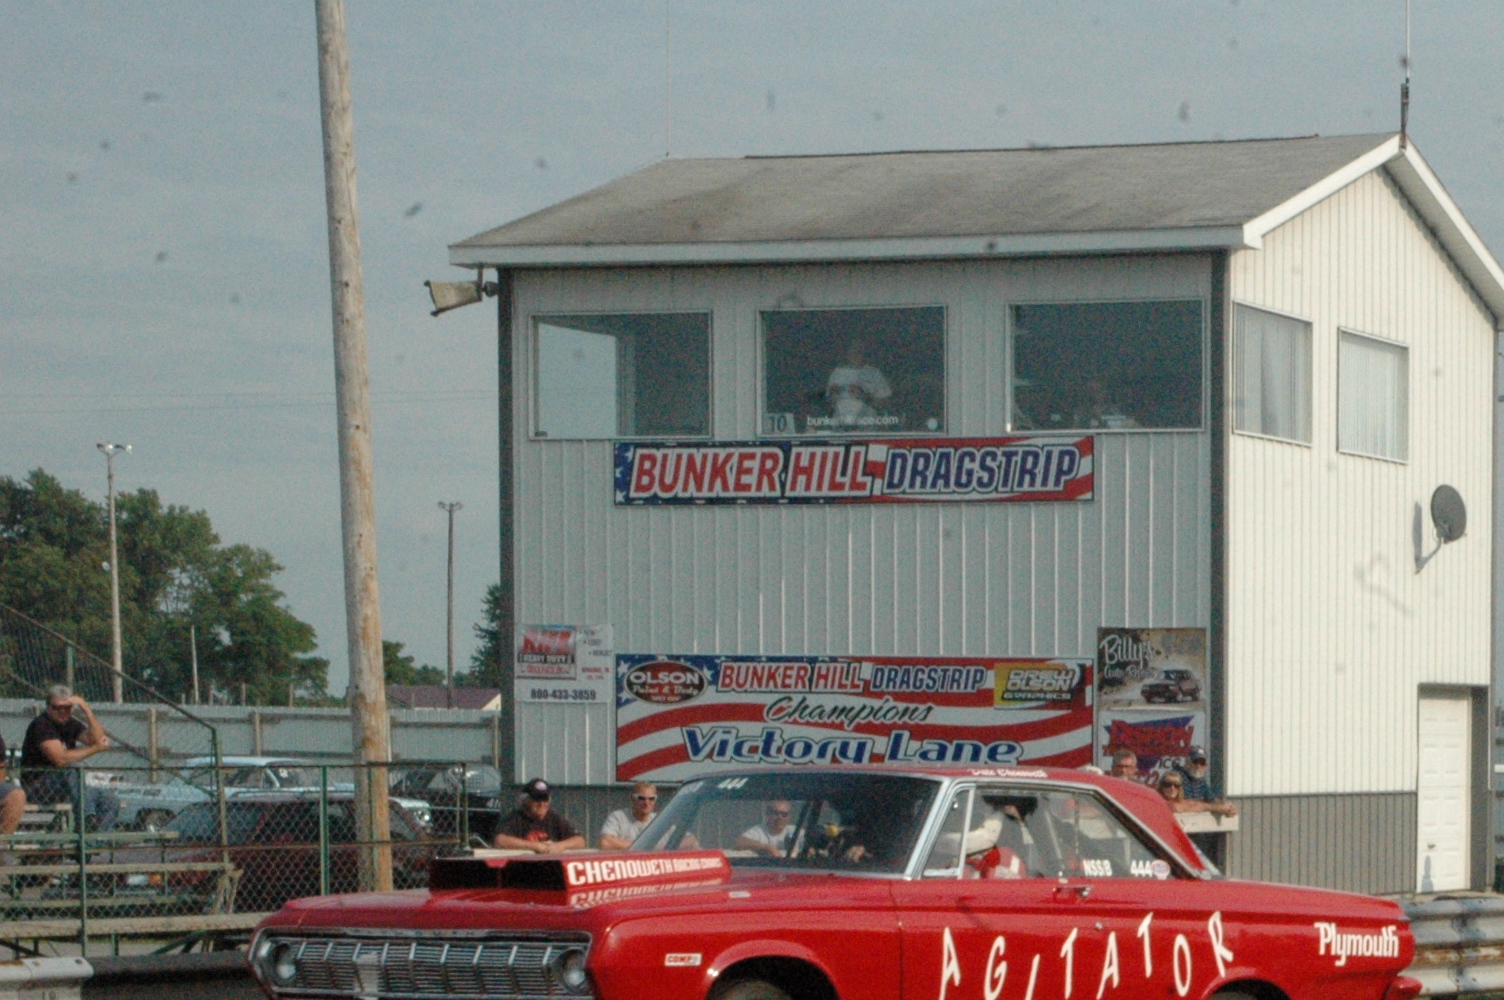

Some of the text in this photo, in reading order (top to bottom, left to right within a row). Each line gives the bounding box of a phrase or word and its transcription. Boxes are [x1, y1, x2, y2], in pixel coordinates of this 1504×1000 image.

[632, 446, 1078, 495] BUNKER HILL DRAGSTRIP
[629, 671, 700, 684] OLSON
[719, 663, 986, 691] BUNKER HILL DRAGSTRIP
[1006, 679, 1072, 691] OLSON
[1008, 669, 1075, 681] DREW
[632, 684, 700, 696] Paint & Body
[765, 695, 934, 728] Champions
[684, 727, 1018, 764] Victory Lane
[566, 858, 673, 886] CHENOWETH
[1130, 859, 1153, 878] 444
[1313, 921, 1400, 967] Plymouth
